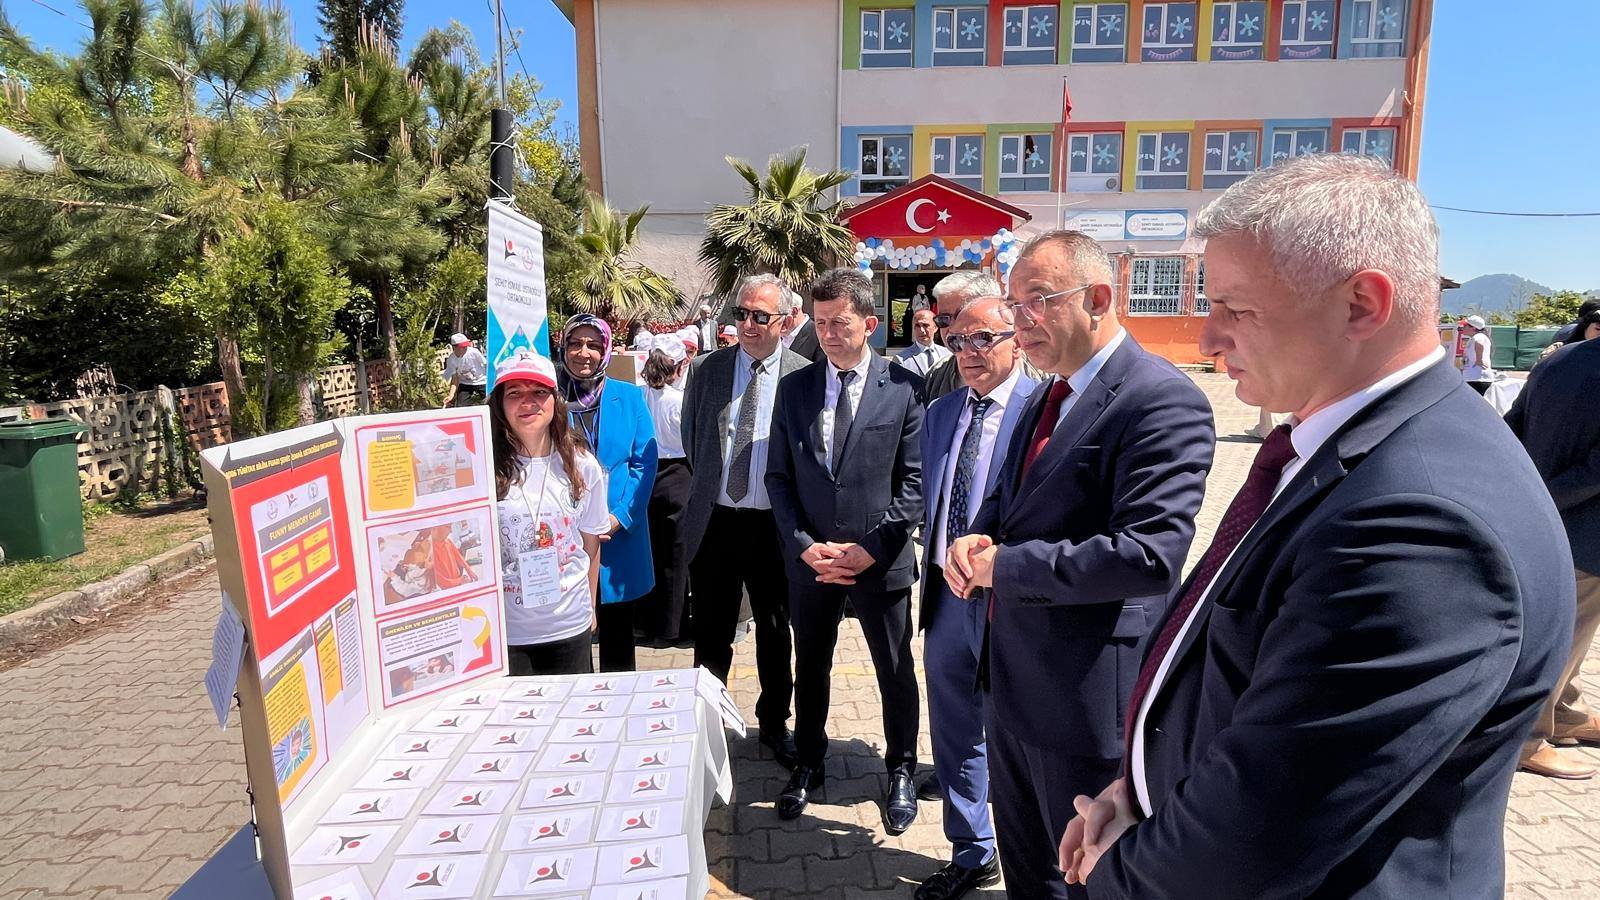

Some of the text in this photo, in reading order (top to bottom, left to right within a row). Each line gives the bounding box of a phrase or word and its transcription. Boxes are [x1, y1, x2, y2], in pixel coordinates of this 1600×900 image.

[269, 507, 322, 541] FUNNY MEMORY GAME
